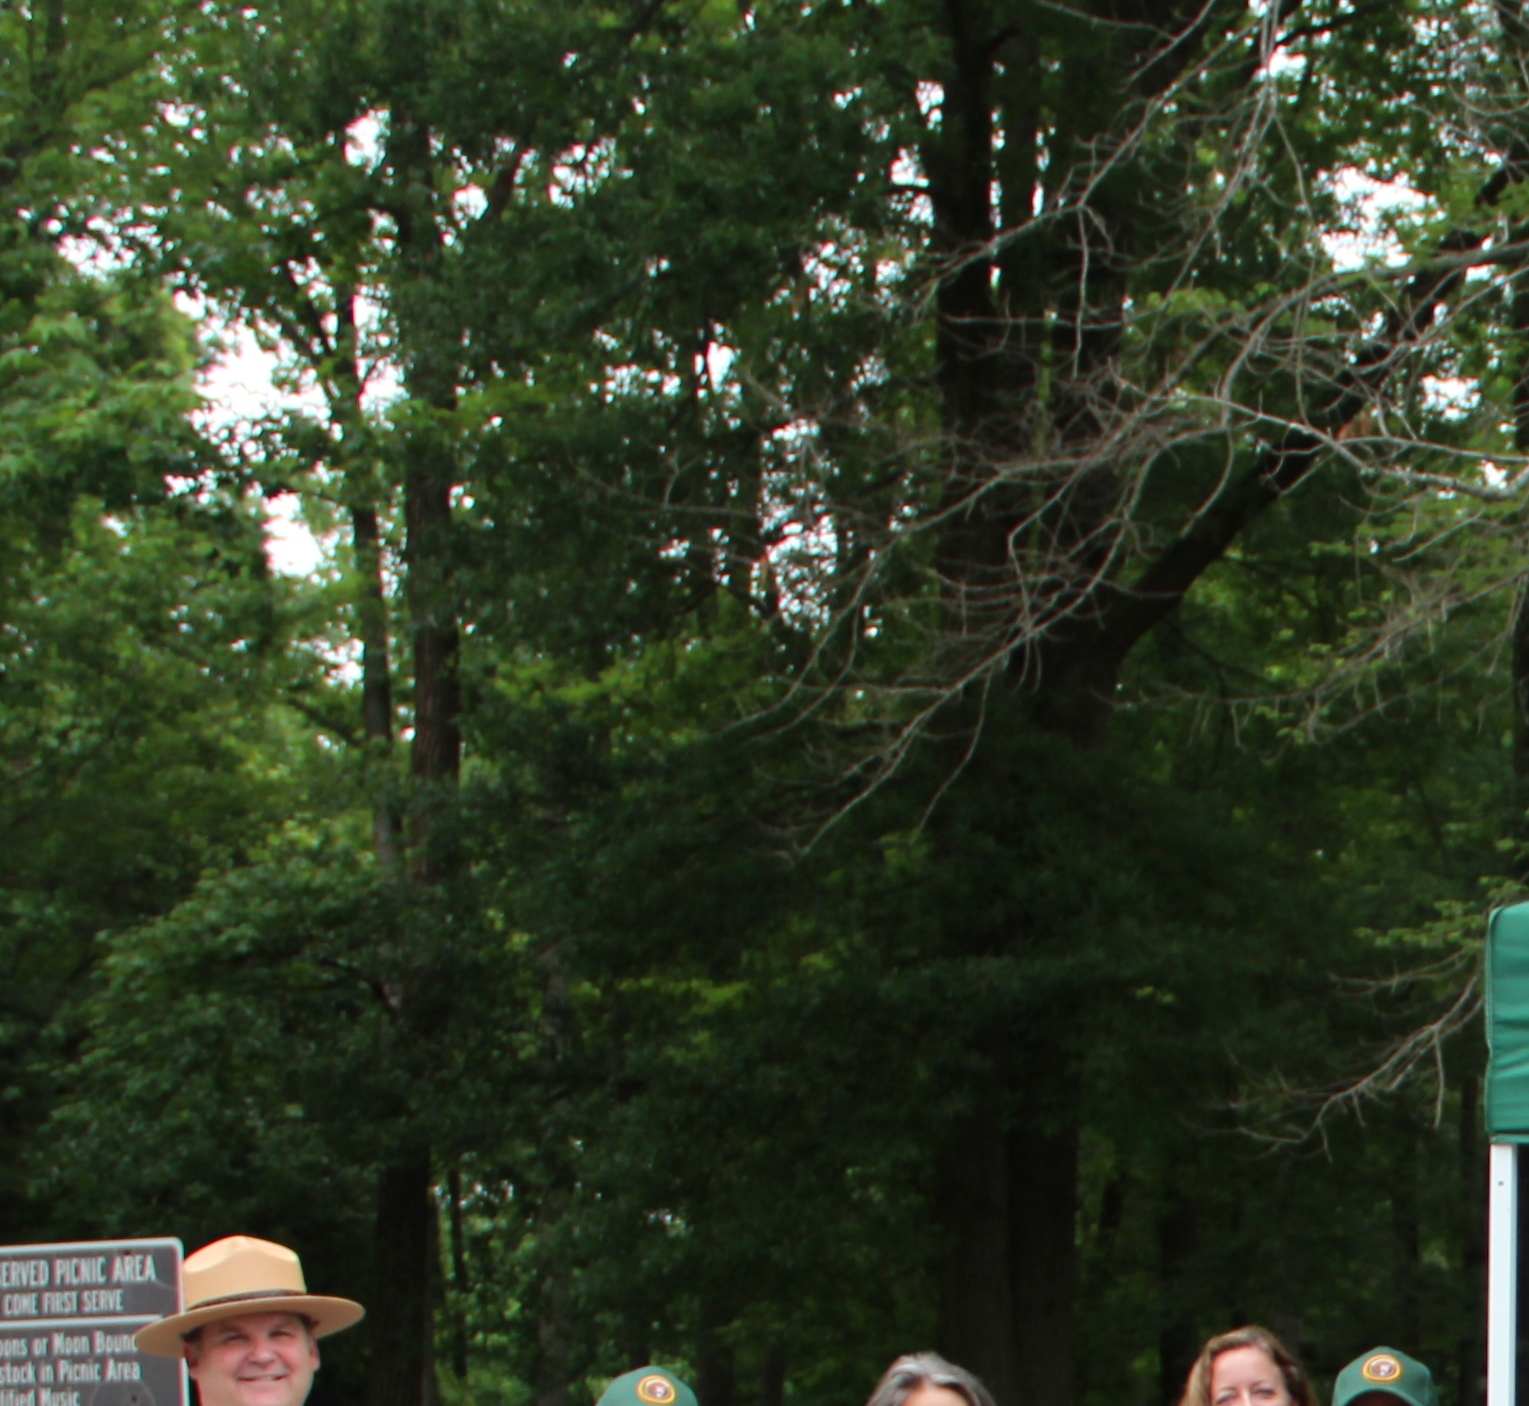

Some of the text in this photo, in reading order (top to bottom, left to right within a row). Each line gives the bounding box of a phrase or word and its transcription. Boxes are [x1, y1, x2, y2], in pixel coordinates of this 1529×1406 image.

[53, 1256, 107, 1286] PICNIC
[111, 1253, 157, 1282] AREA
[3, 1288, 124, 1317] COME FIRST SERVE
[31, 1337, 49, 1356] or
[51, 1331, 91, 1356] Moon
[38, 1362, 55, 1383] in
[57, 1358, 101, 1382] Picnic
[104, 1358, 142, 1381] Area
